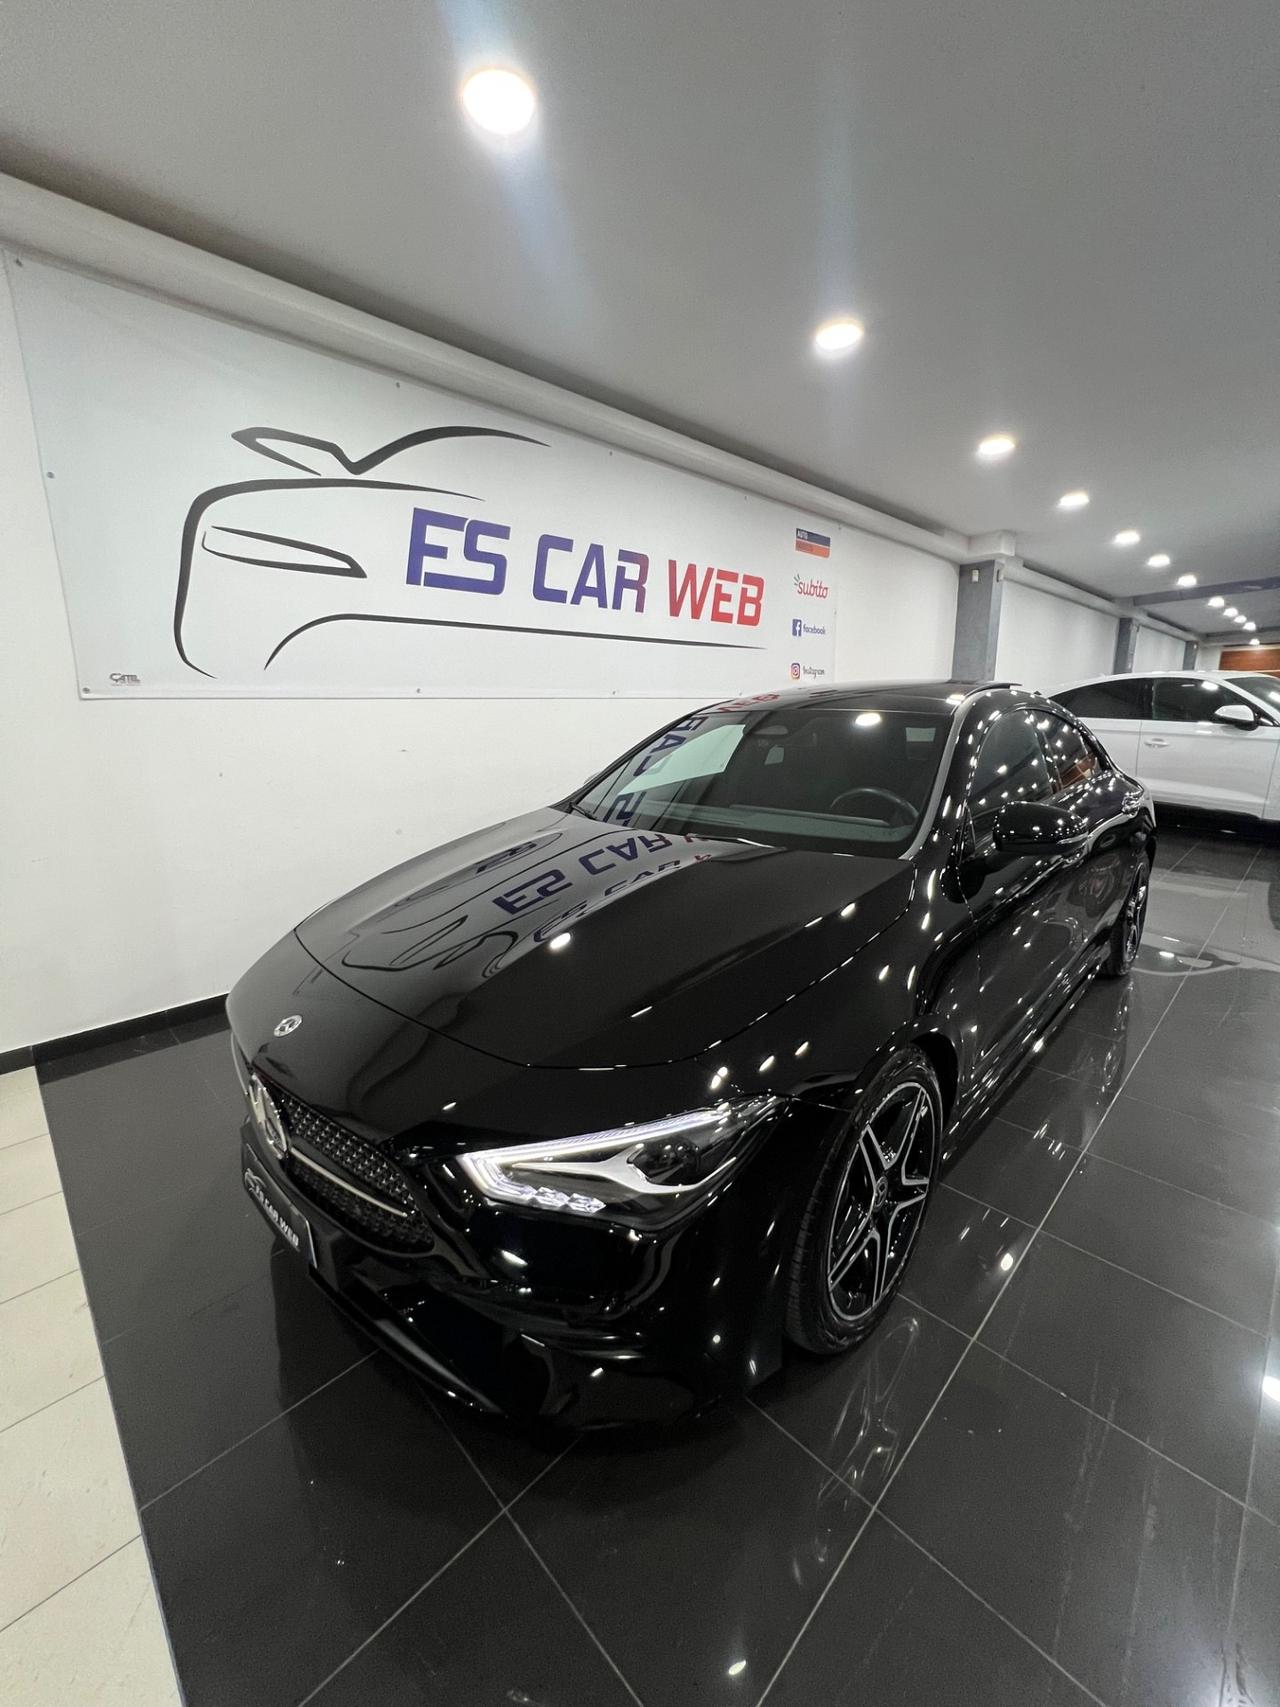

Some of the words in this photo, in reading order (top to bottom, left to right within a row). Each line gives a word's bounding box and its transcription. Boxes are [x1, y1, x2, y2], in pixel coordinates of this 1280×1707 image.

[406, 507, 511, 595] ES
[533, 534, 649, 613] CAR
[668, 559, 765, 627] WEB
[798, 579, 829, 599] subito
[803, 623, 826, 635] facebook
